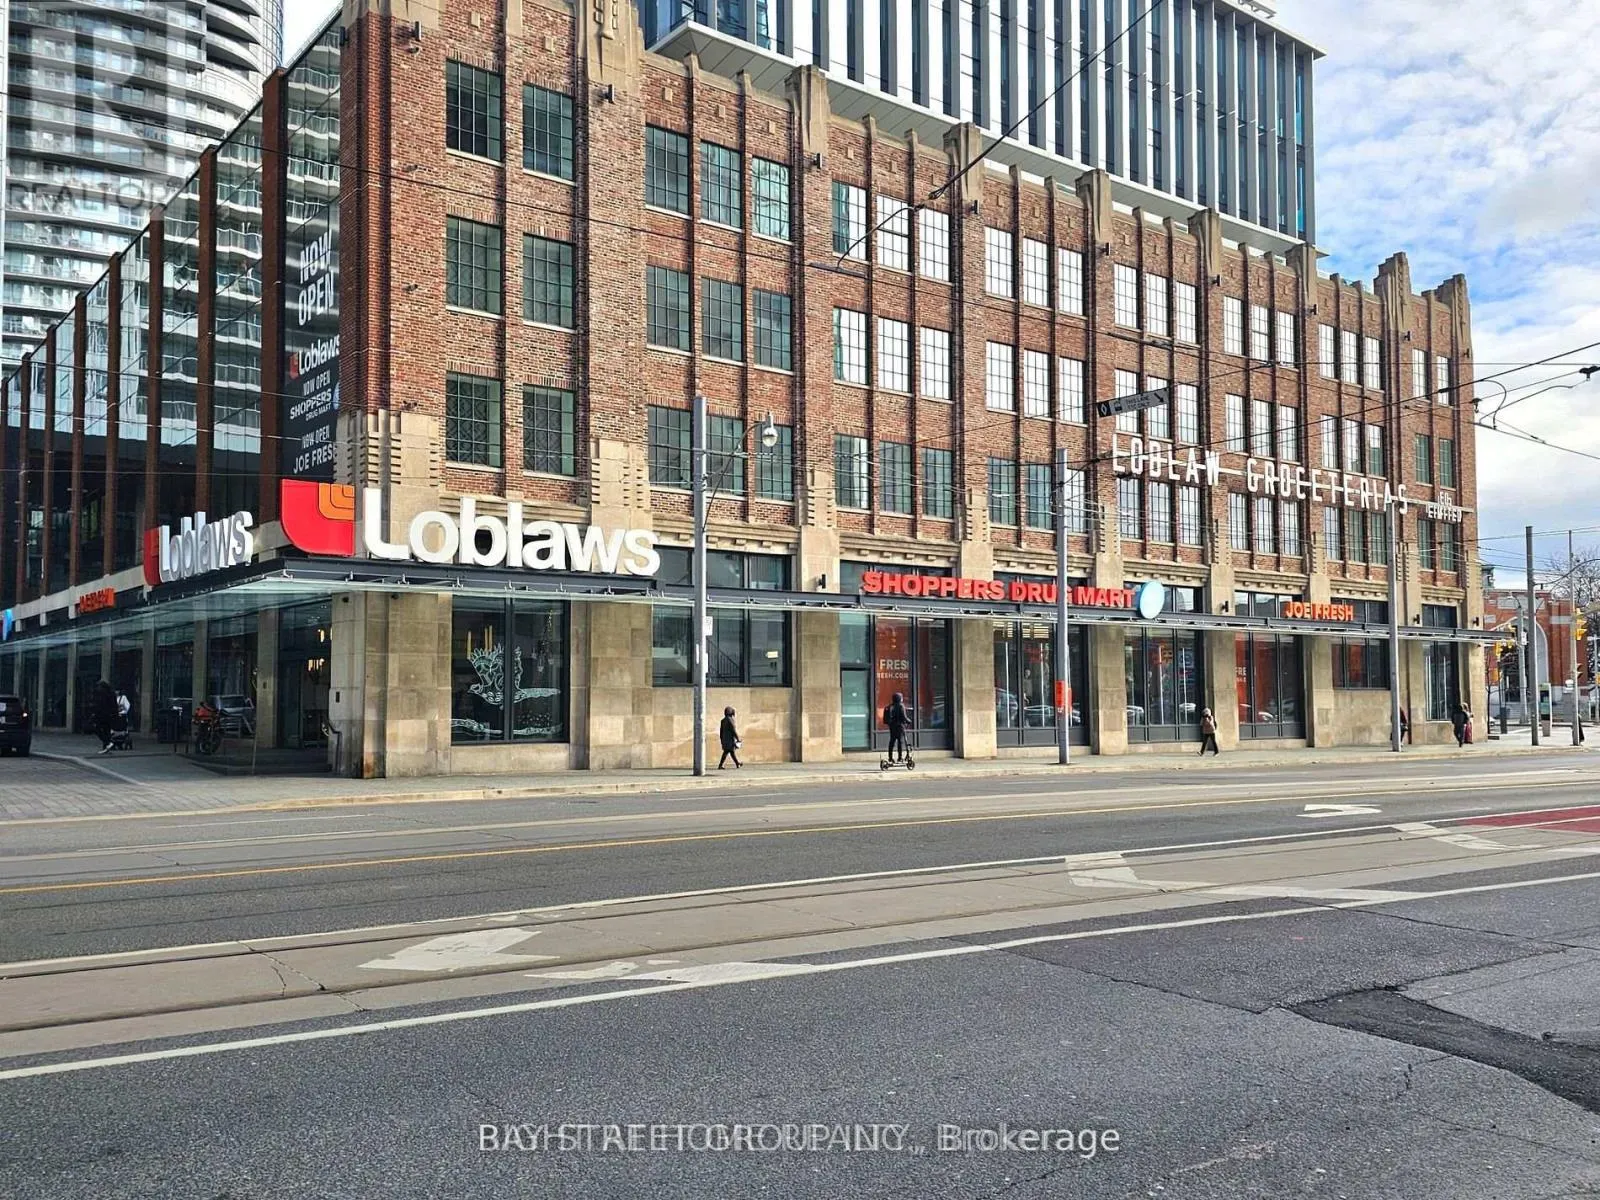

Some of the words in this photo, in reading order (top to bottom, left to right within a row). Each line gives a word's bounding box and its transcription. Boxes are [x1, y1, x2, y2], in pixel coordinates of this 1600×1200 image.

[301, 228, 332, 285] NOW
[299, 270, 334, 326] OPEN
[293, 452, 310, 474] JOE
[312, 443, 334, 467] FRES
[1112, 433, 1220, 486] LOBLAW
[1246, 457, 1408, 515] GROCETERIAS
[159, 511, 253, 583] Loblaws
[363, 486, 661, 576] Loblaws
[863, 571, 1005, 600] SHOPPERS
[1076, 586, 1135, 609] MART
[1285, 601, 1311, 619] JOE
[1312, 603, 1353, 621] FRESH
